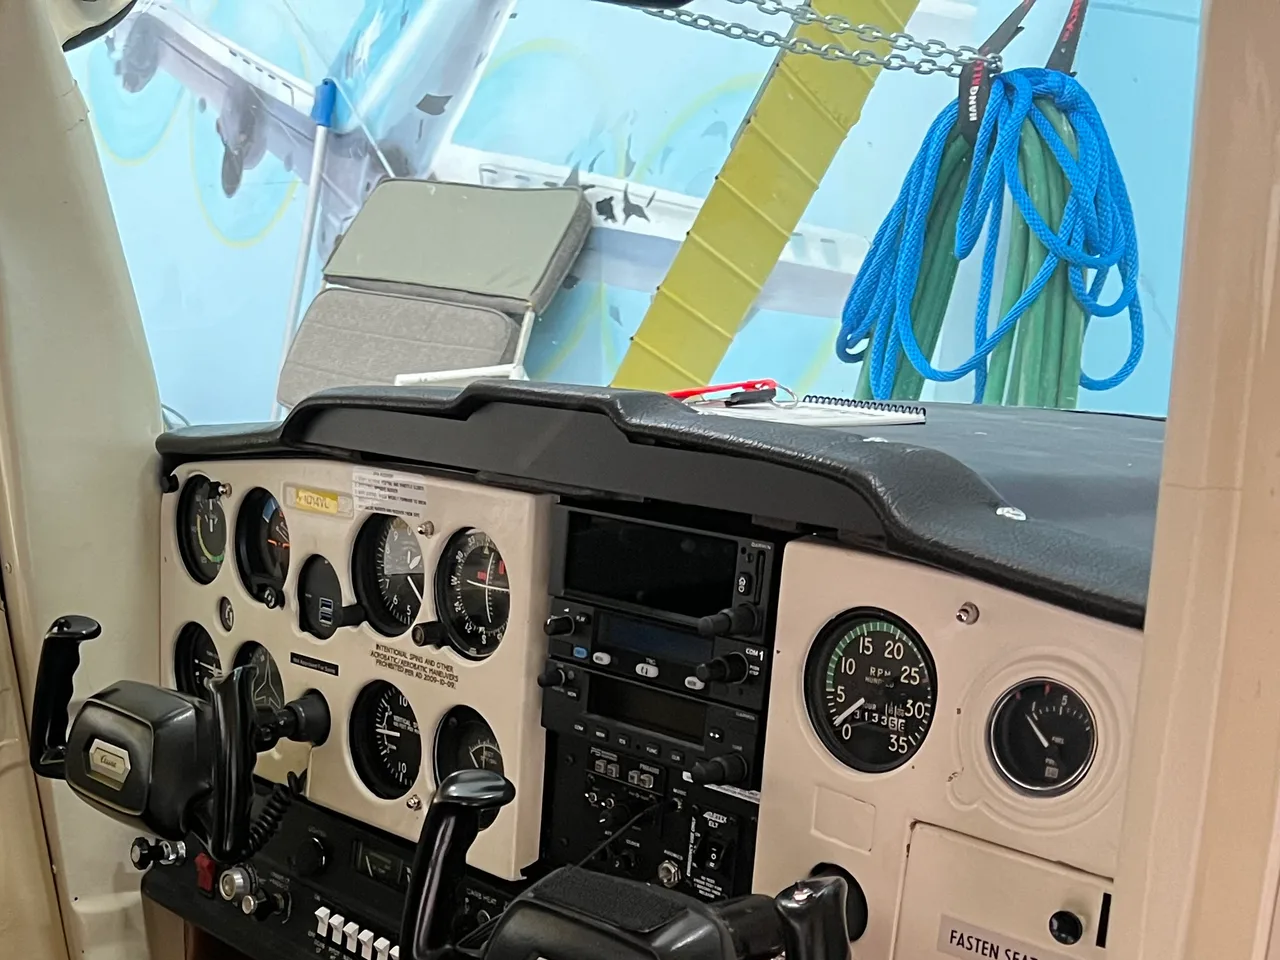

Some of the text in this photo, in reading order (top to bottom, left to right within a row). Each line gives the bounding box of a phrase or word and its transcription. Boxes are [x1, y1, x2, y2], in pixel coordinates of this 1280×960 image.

[393, 594, 399, 605] 6
[406, 604, 412, 616] 5
[859, 636, 873, 655] 15
[884, 640, 904, 660] 20
[375, 643, 454, 673] INTENTIONAL SPINS AND OTHER
[745, 647, 764, 662] COM 1
[404, 667, 414, 677] PER
[841, 656, 856, 675] 10
[869, 666, 891, 678] RPM
[900, 666, 920, 685] 25
[399, 694, 409, 707] 10
[836, 685, 846, 703] 5
[1061, 694, 1068, 706] 5
[904, 699, 925, 719] 30
[842, 723, 852, 740] 0
[888, 734, 908, 754] 35
[398, 761, 407, 773] 10
[949, 929, 1000, 960] FASTEN
